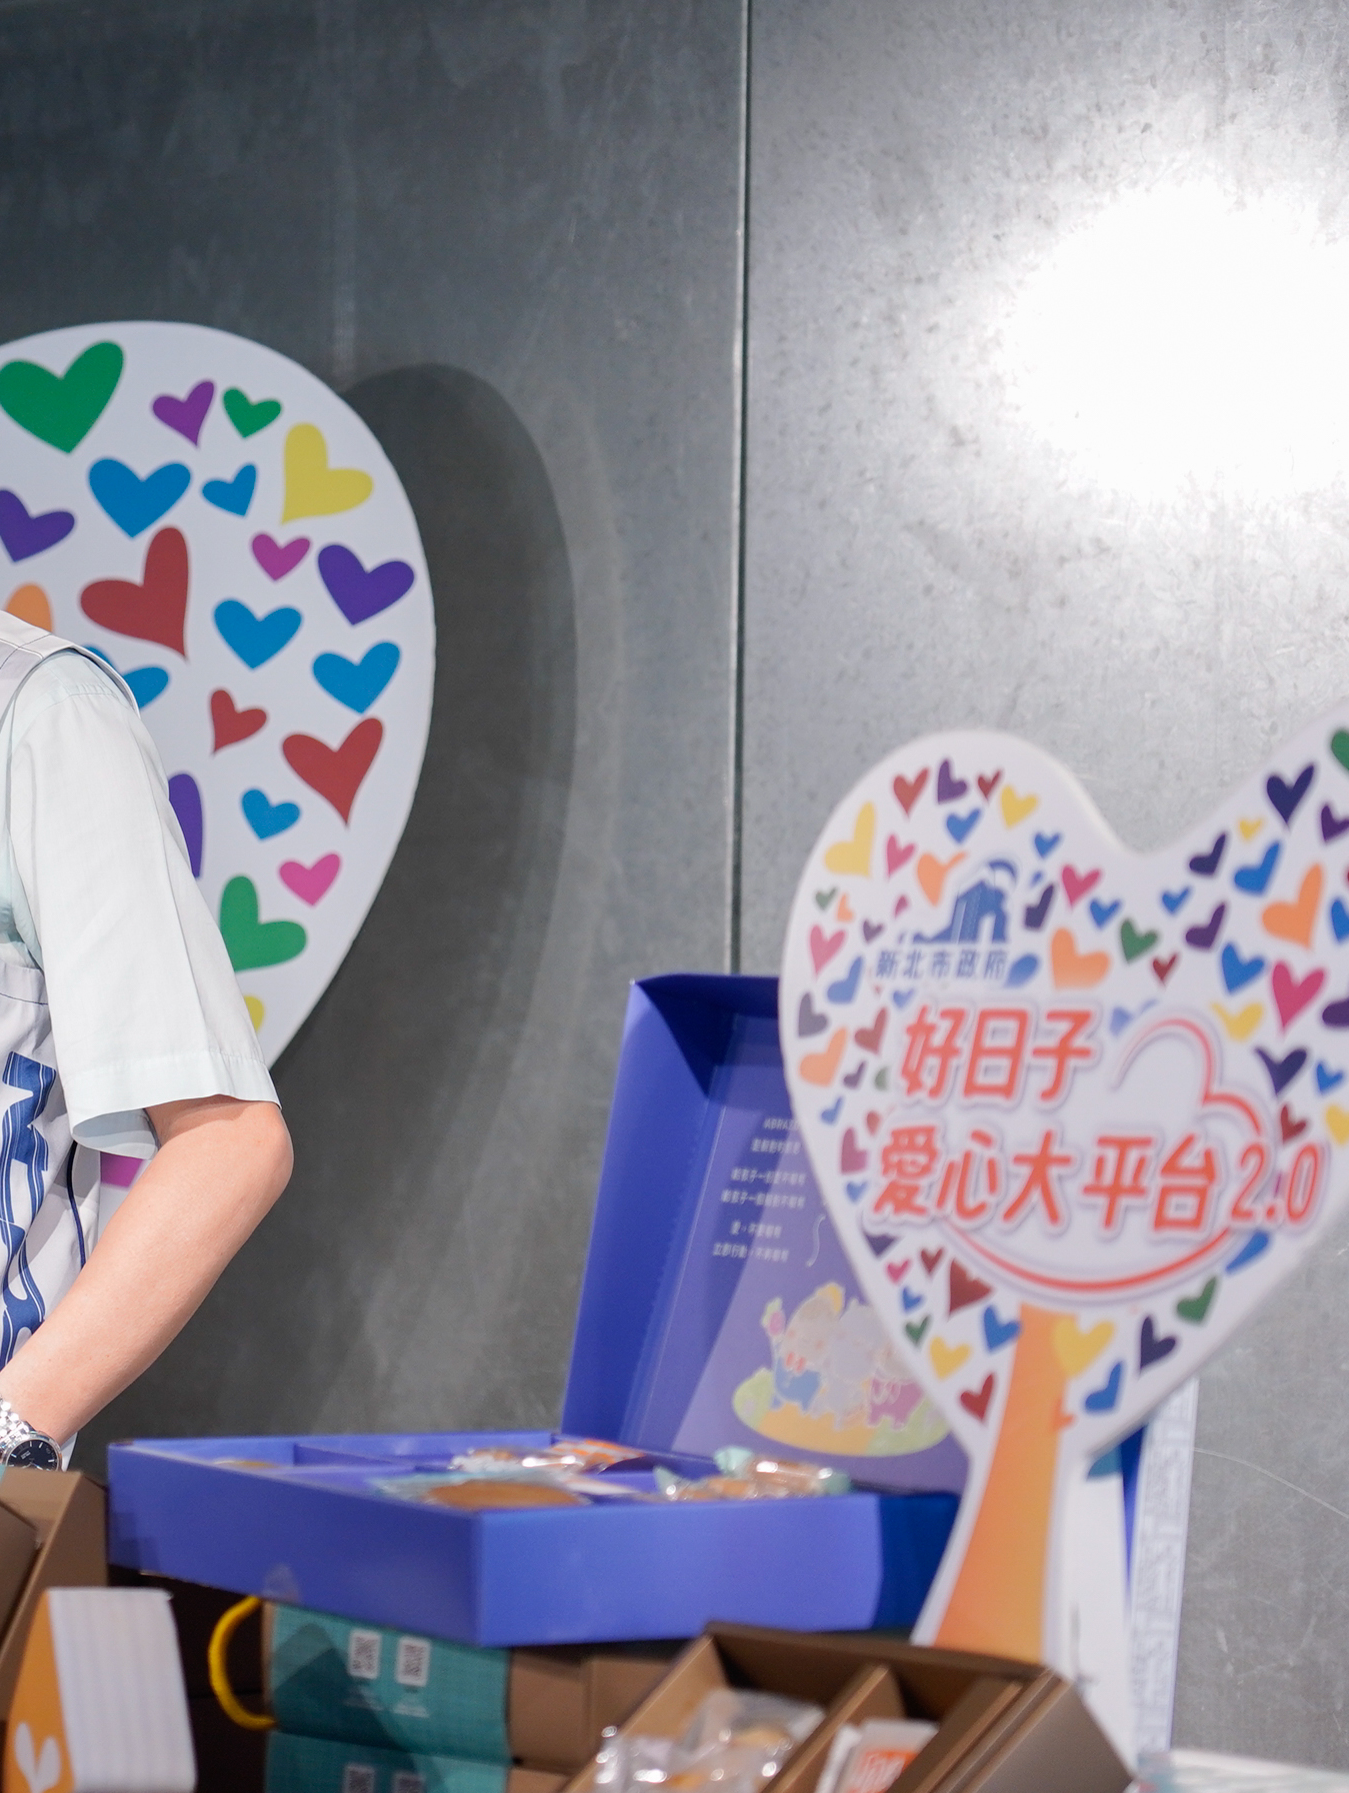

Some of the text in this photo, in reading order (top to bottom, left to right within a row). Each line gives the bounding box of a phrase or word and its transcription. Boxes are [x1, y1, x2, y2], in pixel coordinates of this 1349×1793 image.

[875, 949, 1009, 979] 新北市政府
[900, 1006, 1094, 1101] 好日子
